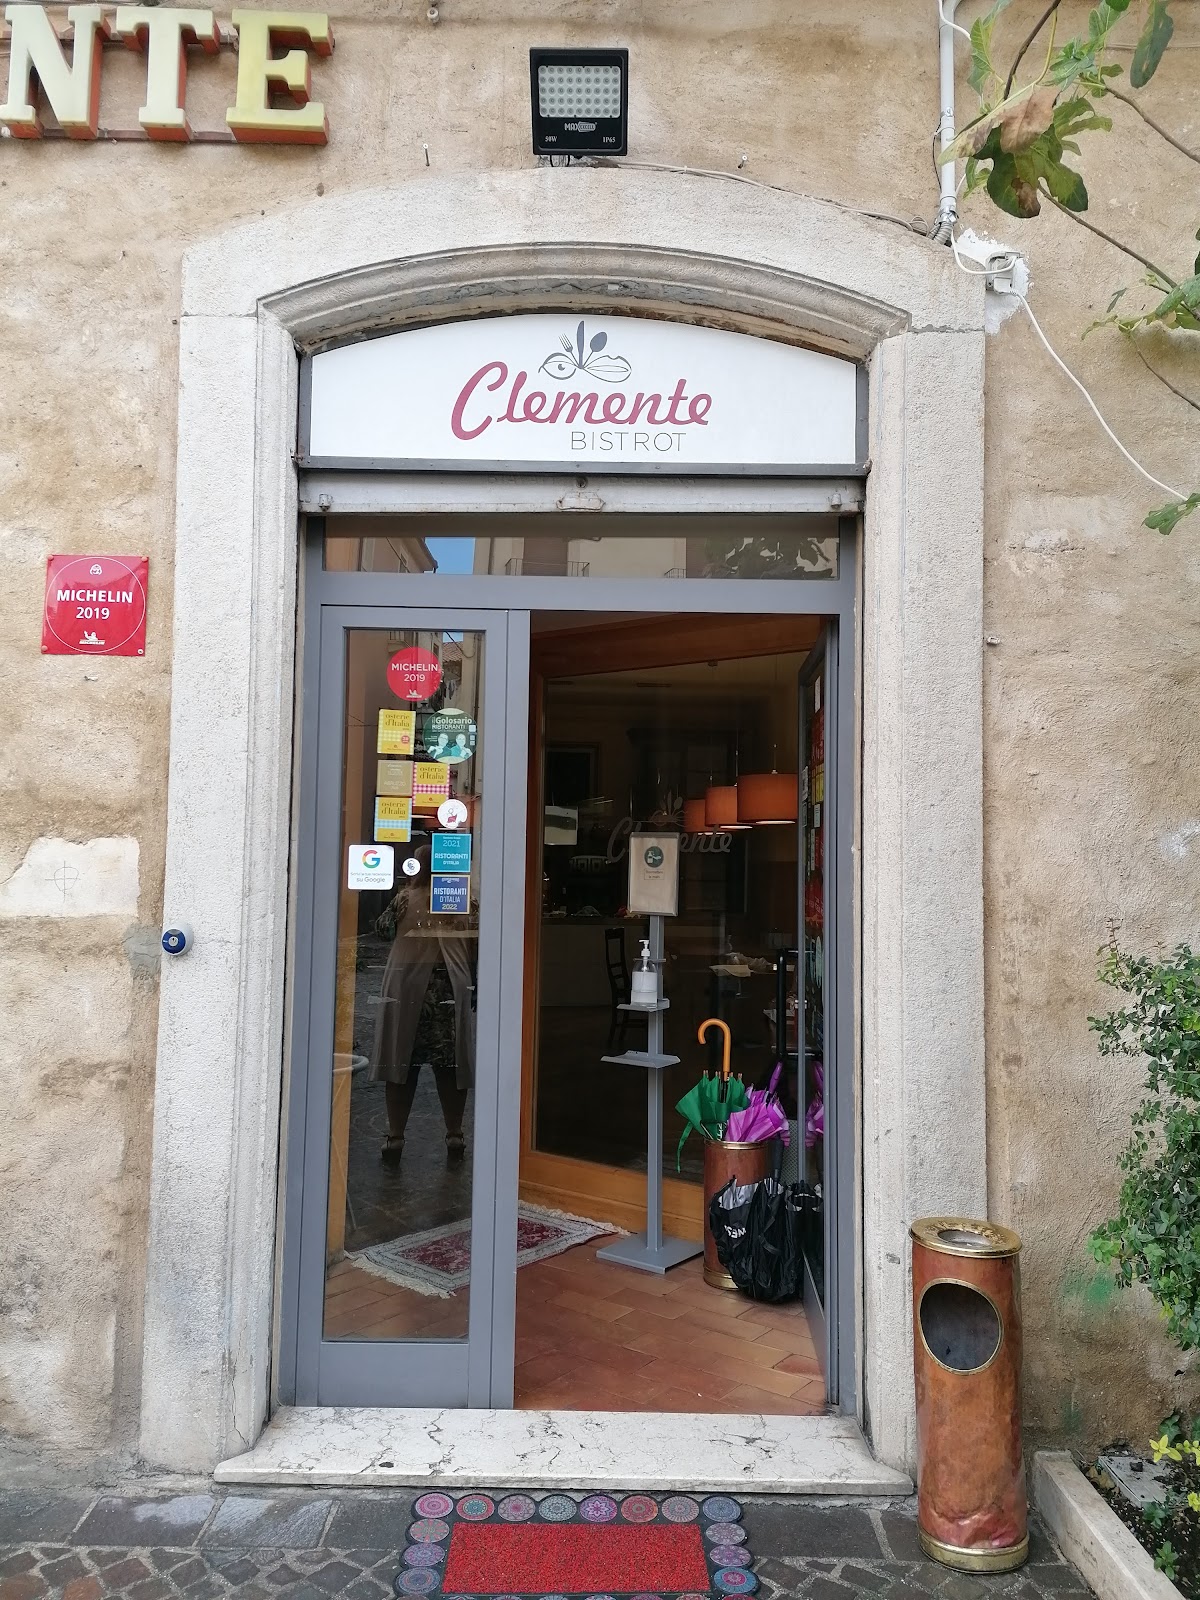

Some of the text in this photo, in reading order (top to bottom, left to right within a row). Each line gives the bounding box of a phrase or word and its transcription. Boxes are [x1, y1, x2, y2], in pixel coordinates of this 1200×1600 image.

[0, 5, 332, 142] NTE
[451, 361, 713, 441] Clemente
[570, 431, 687, 452] BISTROT
[56, 589, 133, 604] MICHELIN
[75, 607, 110, 620] 2019
[391, 663, 438, 672] MICHELIN
[403, 674, 426, 682] 2019
[442, 840, 461, 848] 2021
[364, 876, 386, 884] Google
[433, 887, 467, 896] RISTORANTI
